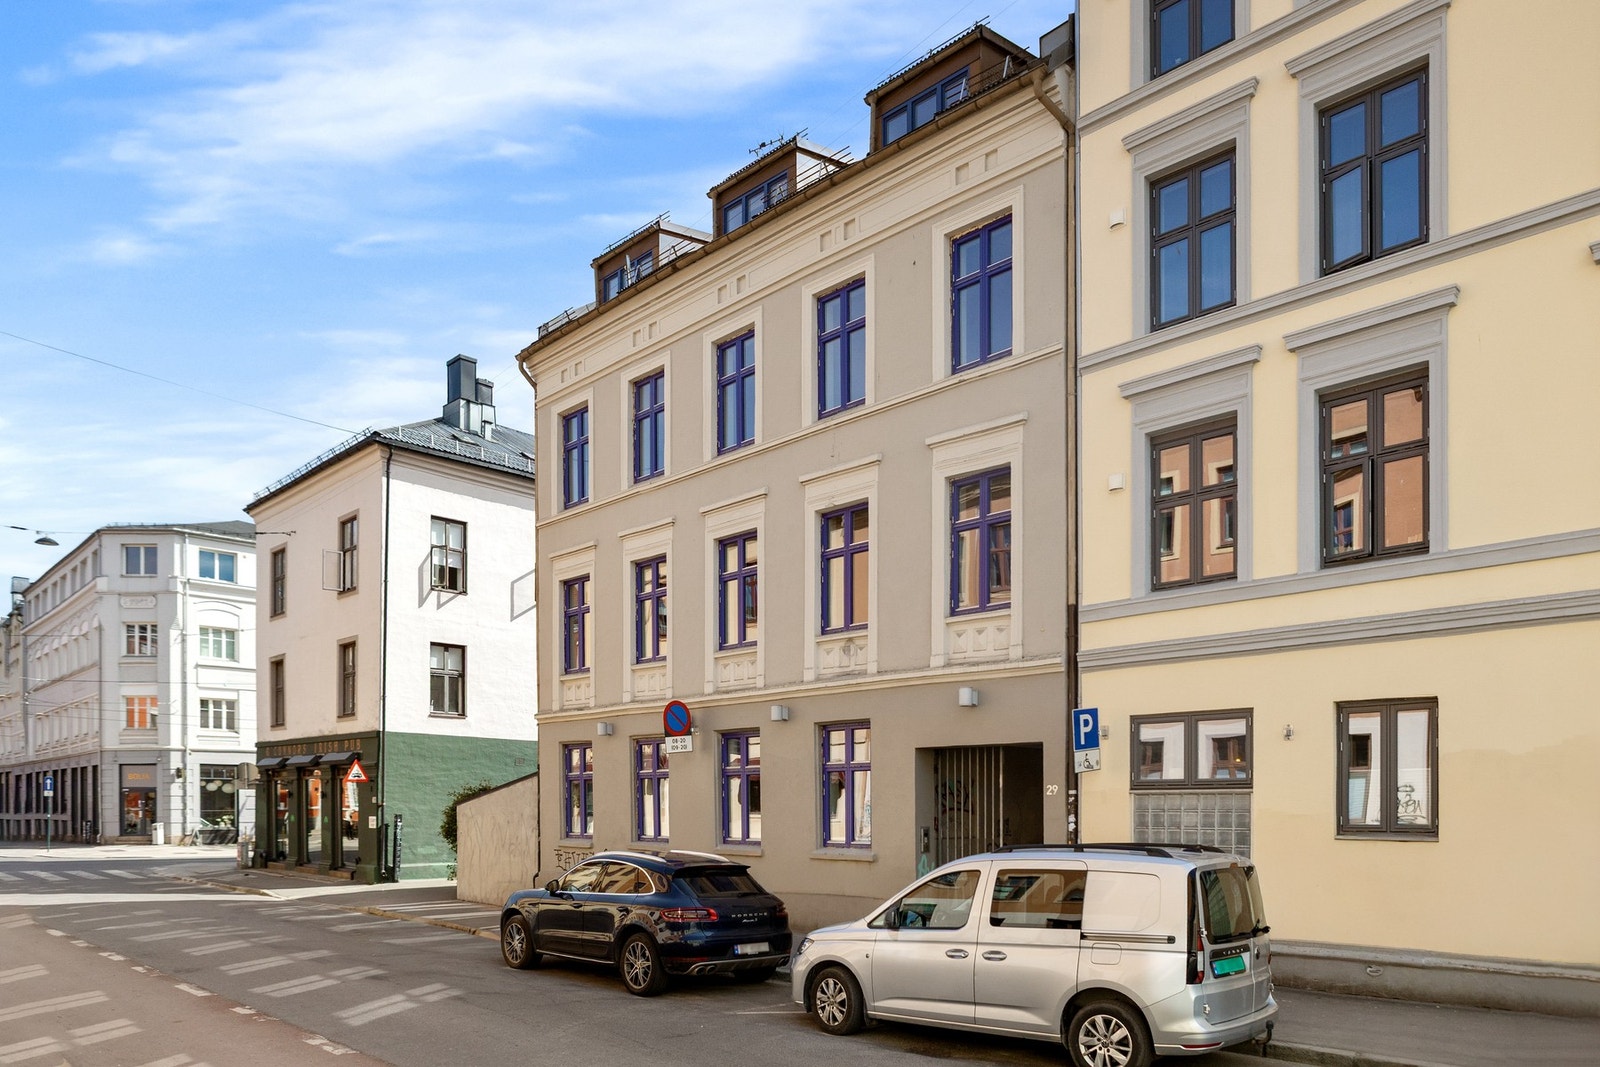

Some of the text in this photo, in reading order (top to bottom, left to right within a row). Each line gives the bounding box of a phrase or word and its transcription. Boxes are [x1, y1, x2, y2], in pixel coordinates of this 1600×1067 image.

[1079, 713, 1093, 745] P
[314, 741, 338, 753] IRISH
[344, 739, 361, 751] PUB
[1046, 784, 1059, 795] 29
